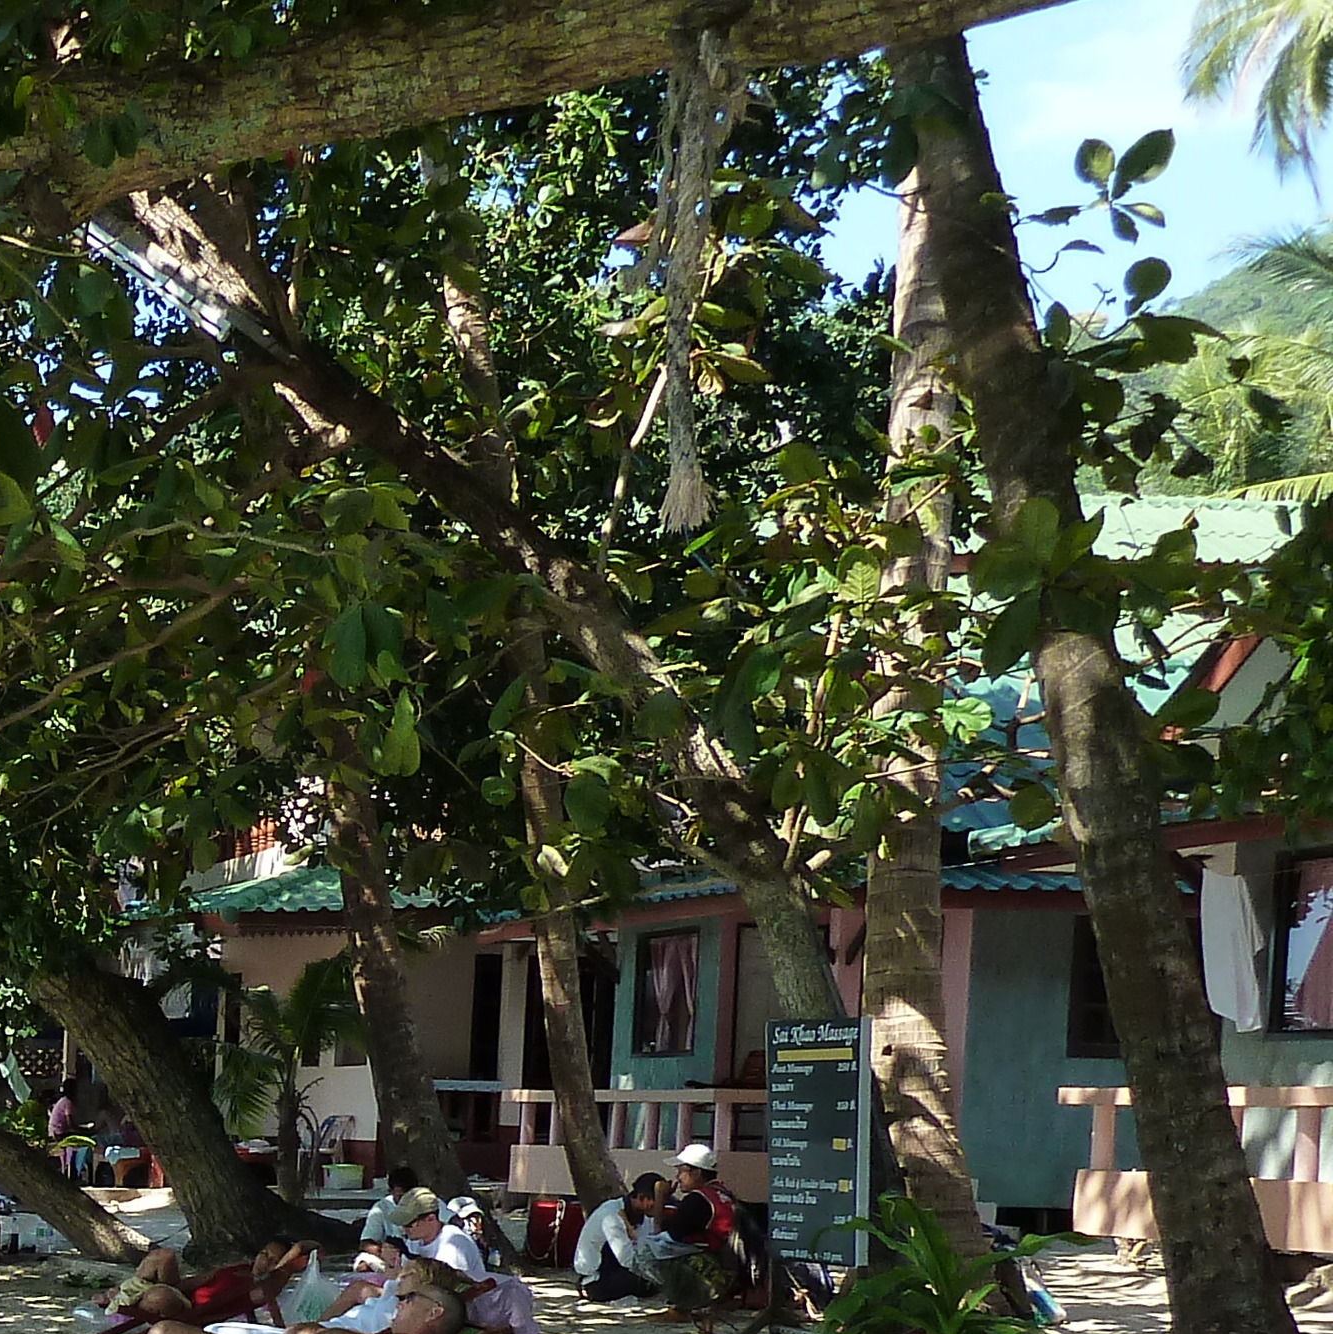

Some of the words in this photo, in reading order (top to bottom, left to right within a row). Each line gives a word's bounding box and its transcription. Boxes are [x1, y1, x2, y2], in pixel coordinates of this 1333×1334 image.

[772, 1026, 789, 1045] Sai
[790, 1024, 815, 1046] Khao
[817, 1022, 859, 1046] Massage
[771, 1063, 786, 1073] Foot
[787, 1063, 813, 1076] Massage
[772, 1100, 786, 1111] Thai
[787, 1100, 813, 1113] Massage
[771, 1137, 781, 1147] Oil
[782, 1137, 807, 1151] Massage
